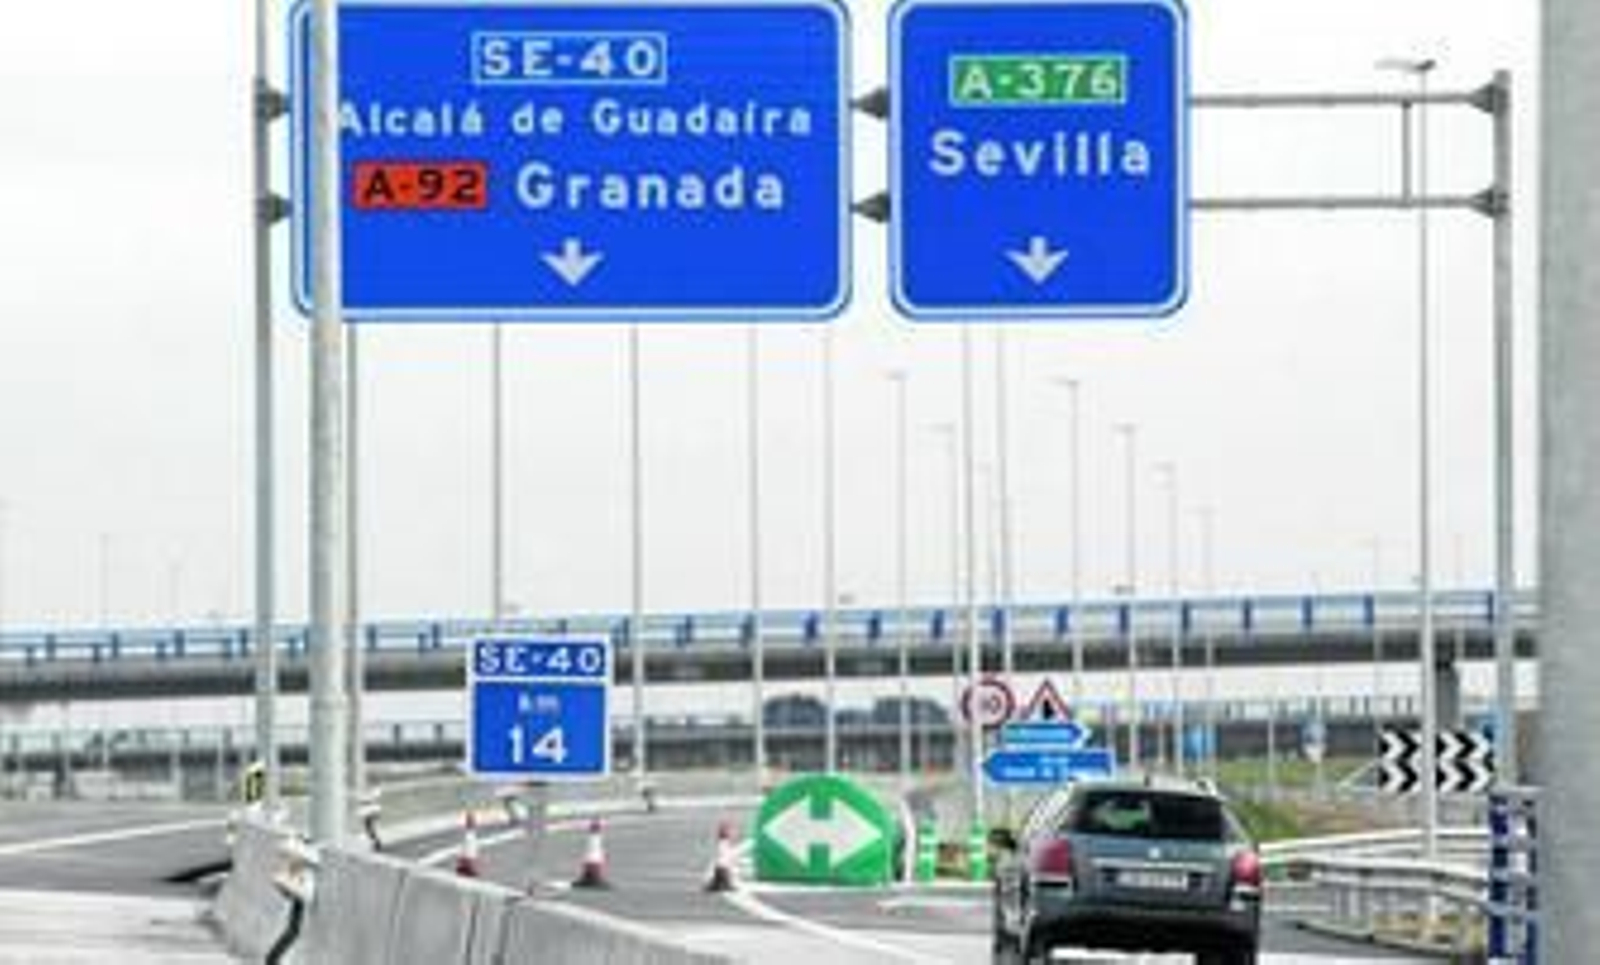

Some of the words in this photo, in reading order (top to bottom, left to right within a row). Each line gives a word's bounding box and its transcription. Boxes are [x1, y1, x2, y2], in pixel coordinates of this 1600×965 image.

[482, 40, 660, 77] SE-40
[959, 62, 1117, 99] A-376
[510, 102, 565, 134] de
[929, 129, 1151, 177] Sevilla
[363, 169, 481, 201] A-92
[515, 162, 784, 210] Granada
[478, 646, 602, 673] SE-40
[507, 724, 568, 765] 14
